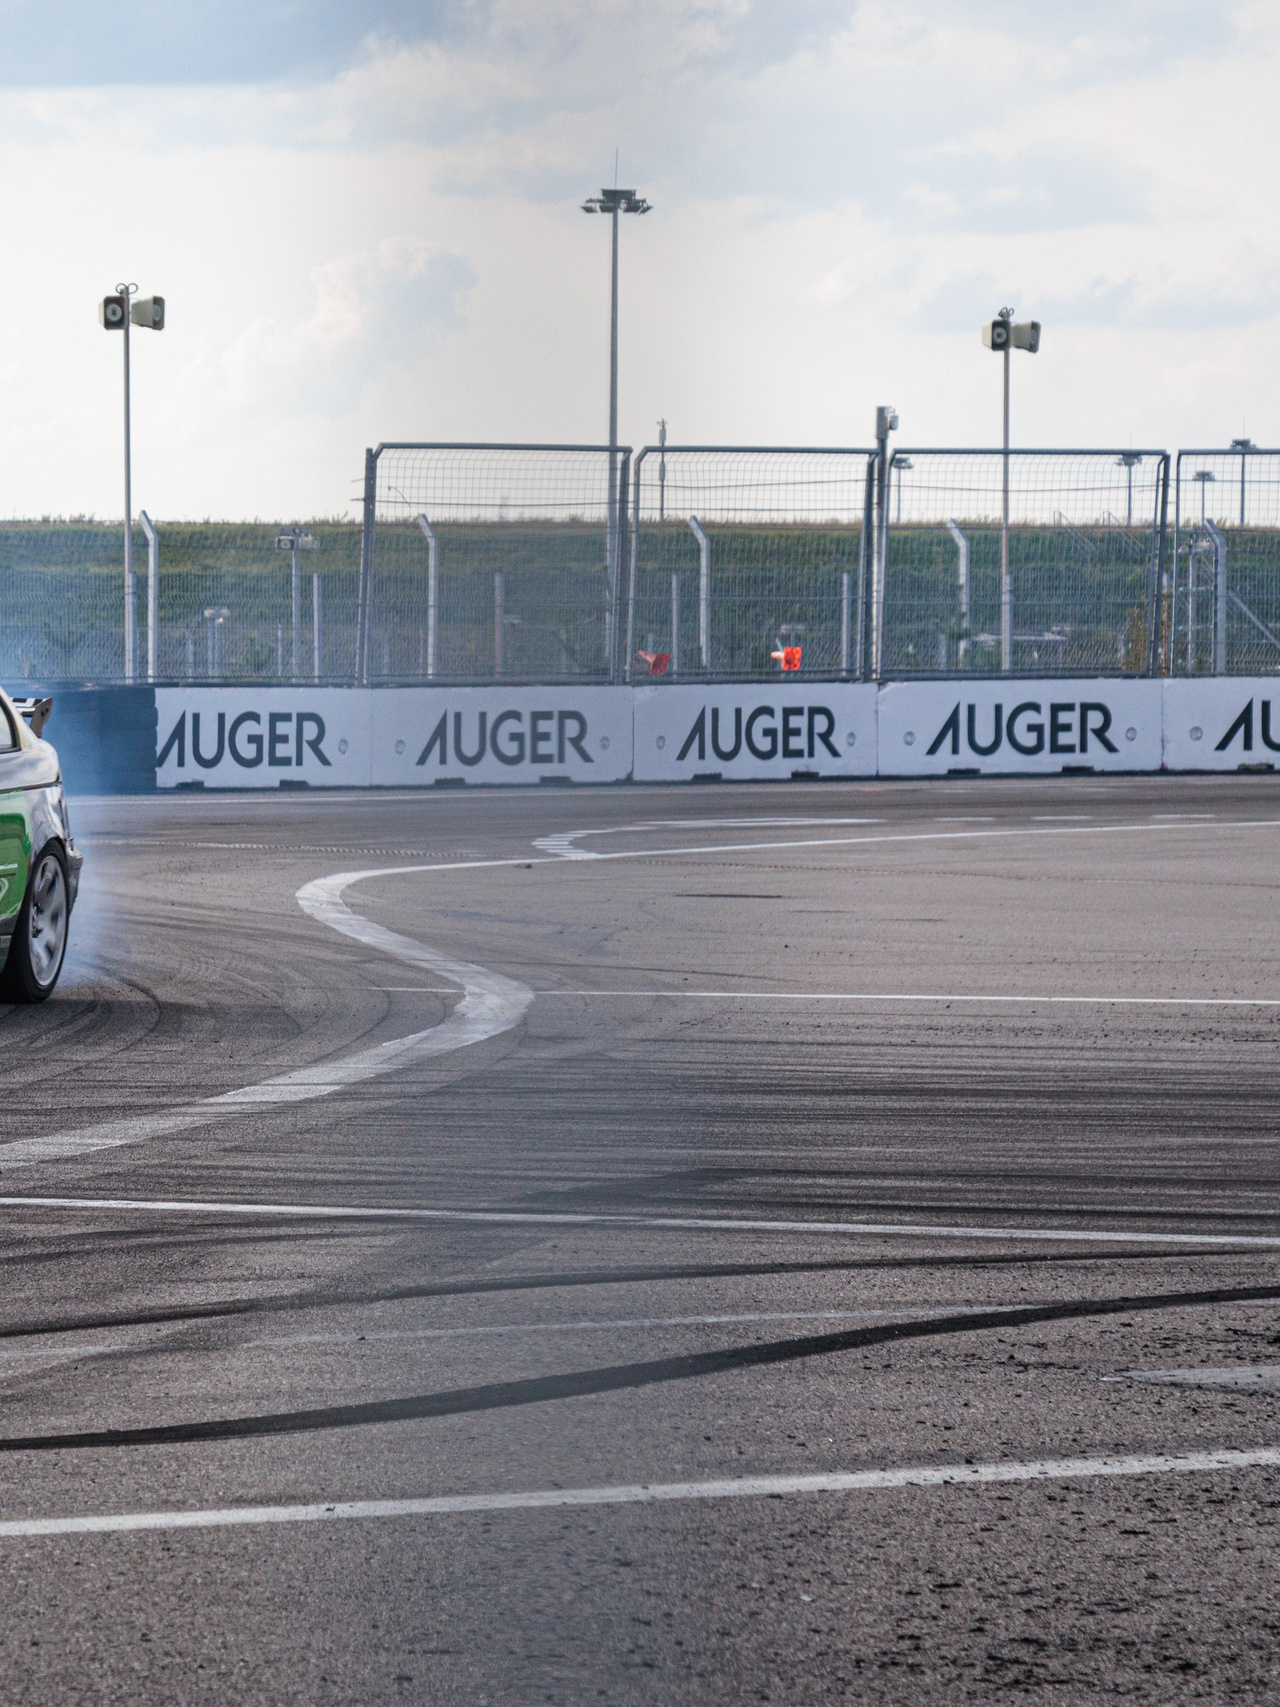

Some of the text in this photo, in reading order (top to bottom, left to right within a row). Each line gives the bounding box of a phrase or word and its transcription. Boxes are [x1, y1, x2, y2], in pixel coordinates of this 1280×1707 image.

[156, 709, 333, 769] AUGER
[416, 709, 595, 767] AUGER
[676, 705, 841, 761] AUGER
[925, 701, 1119, 755] AUGER
